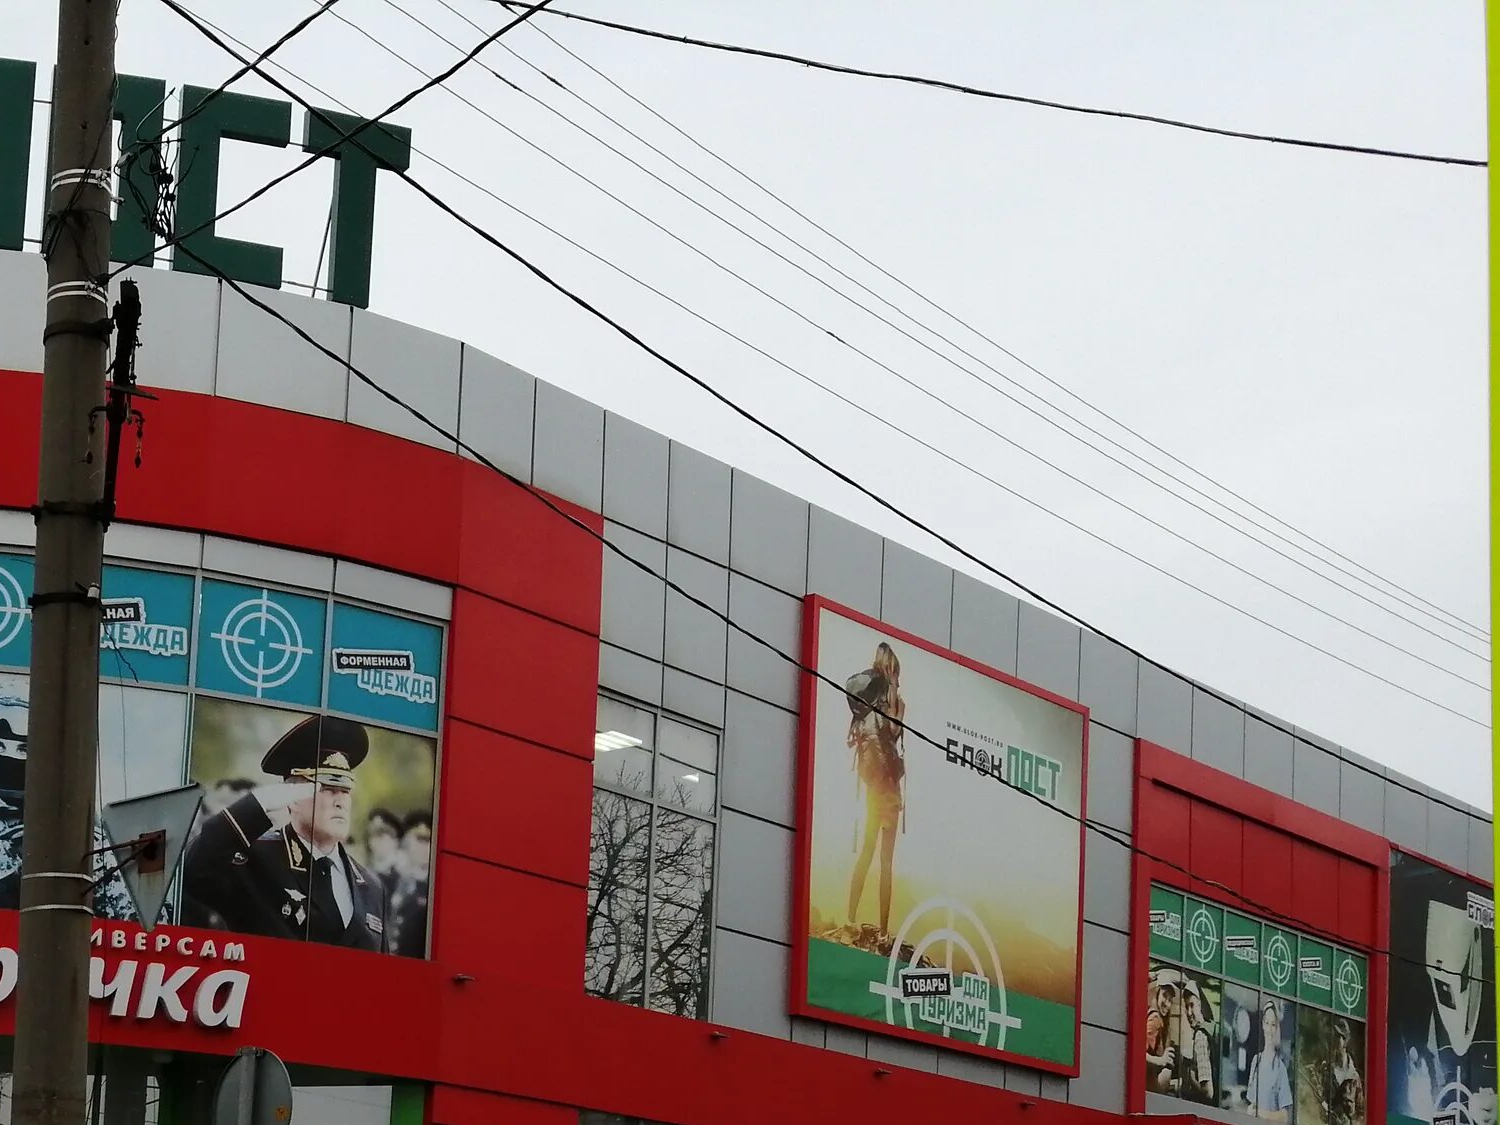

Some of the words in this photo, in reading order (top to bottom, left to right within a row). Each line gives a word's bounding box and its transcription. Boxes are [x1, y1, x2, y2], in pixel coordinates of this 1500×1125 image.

[100, 623, 184, 652] ДЕЖДА
[340, 656, 408, 667] ФОРМЕННАЯ
[361, 668, 433, 700] ОДЕЖДА
[946, 738, 1061, 801] БЛОКПОСТ
[90, 927, 246, 962] ИВЕРСАМ
[905, 978, 947, 993] ТОВАРЫ
[963, 976, 987, 1000] ДЛЯ
[921, 996, 986, 1030] ТУРИЗМА
